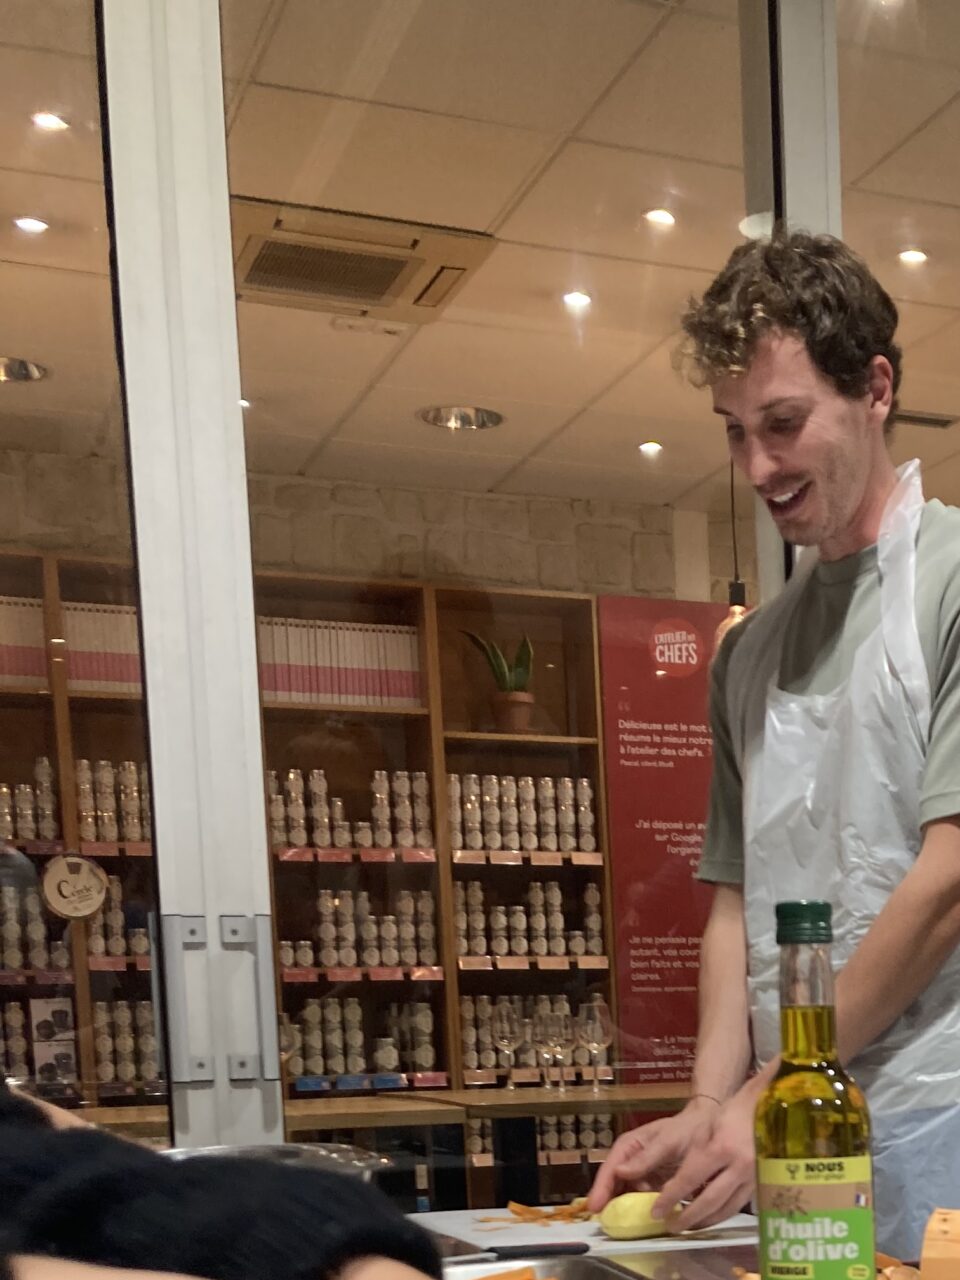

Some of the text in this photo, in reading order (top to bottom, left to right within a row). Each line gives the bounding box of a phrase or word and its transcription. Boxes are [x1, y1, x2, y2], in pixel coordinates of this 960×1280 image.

[655, 643, 698, 665] CHEFS
[664, 723, 678, 732] est
[680, 723, 688, 732] le
[689, 724, 707, 733] mot
[653, 733, 661, 743] le
[662, 735, 687, 744] mieux
[627, 744, 659, 755] l'atelier
[660, 747, 676, 756] des
[678, 747, 704, 758] chefs.
[635, 819, 650, 829] J'ai
[652, 820, 683, 830] déposé
[629, 936, 640, 944] Je
[630, 959, 649, 969] bien
[805, 1162, 845, 1173] NOUS
[767, 1217, 849, 1239] l'huile
[767, 1240, 860, 1261] d'olive
